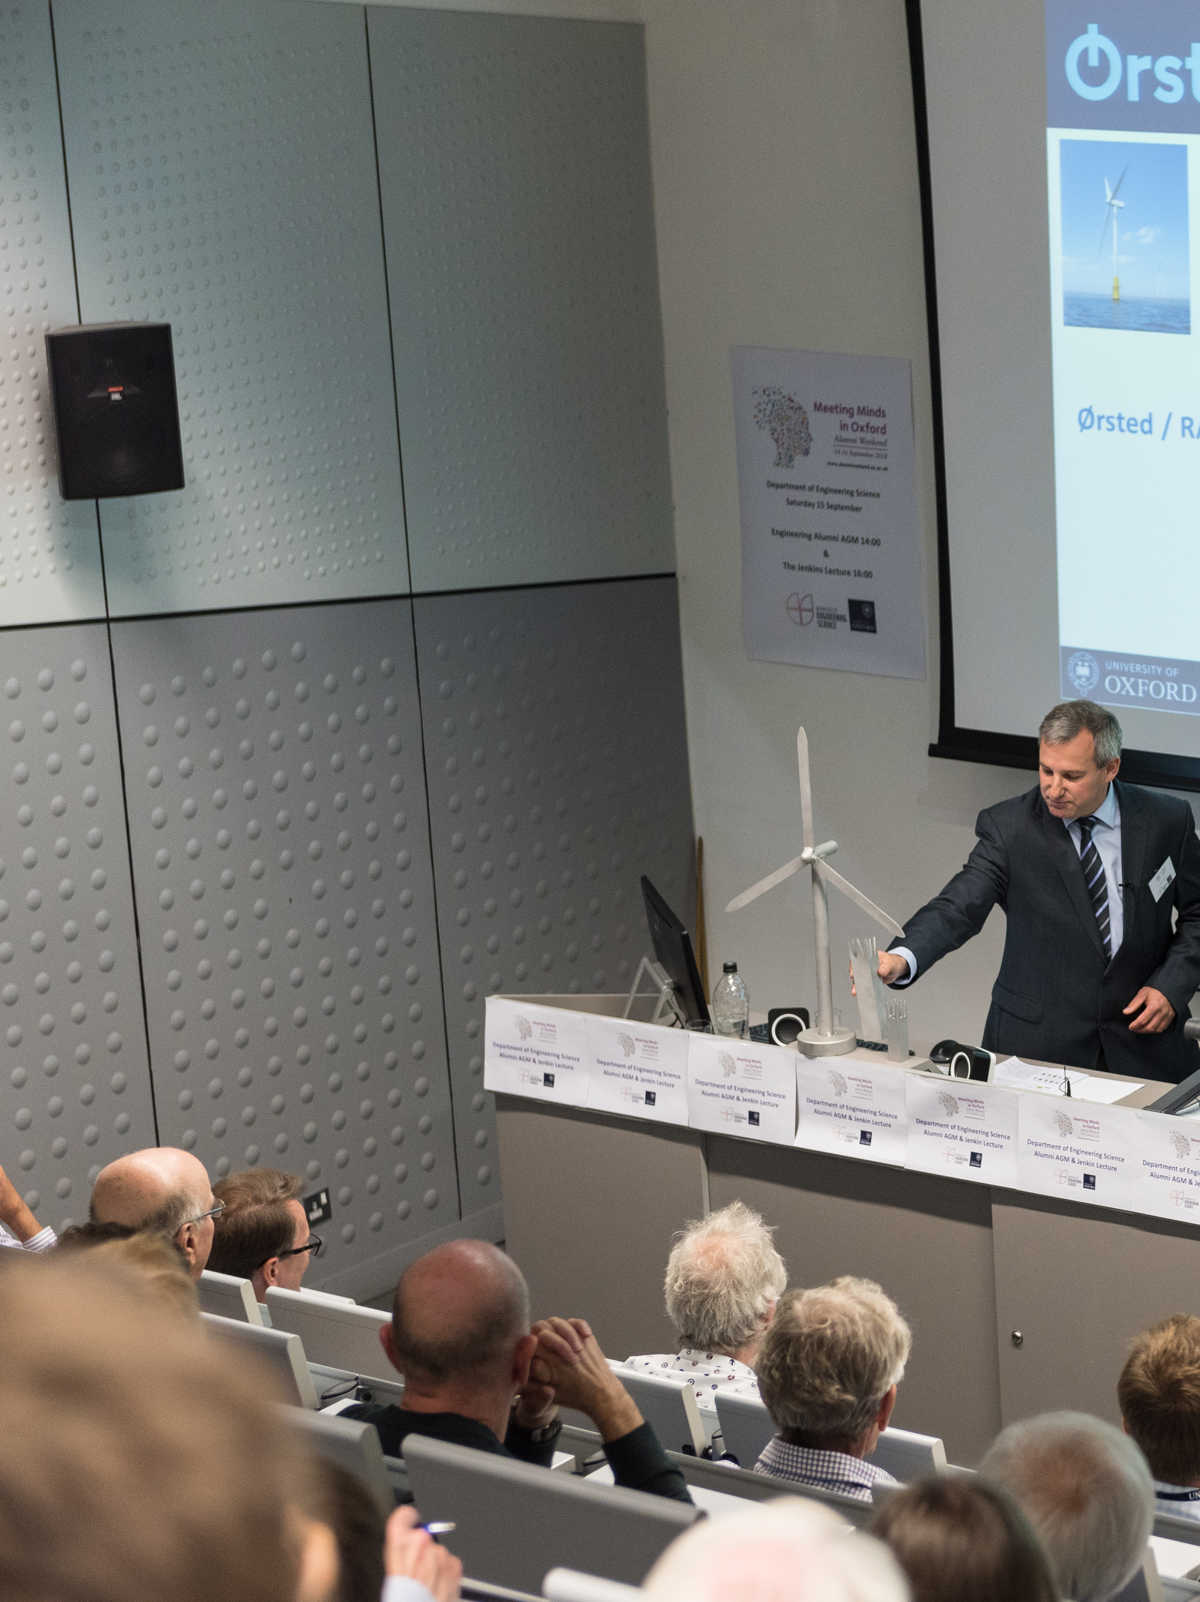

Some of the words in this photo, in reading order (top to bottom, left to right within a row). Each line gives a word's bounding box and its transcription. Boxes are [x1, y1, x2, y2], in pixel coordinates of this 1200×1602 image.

[813, 401, 855, 419] Meeting
[856, 405, 887, 418] Minds
[840, 420, 849, 432] in
[850, 421, 887, 436] Oxford
[1077, 405, 1153, 436] Ørsted
[1160, 411, 1173, 441] /
[766, 479, 806, 491] Department
[808, 484, 815, 492] of
[816, 484, 855, 498] Engineering
[856, 488, 881, 499] Science
[786, 497, 816, 510] Saturday
[817, 501, 825, 509] 15
[826, 501, 863, 512] September
[771, 528, 812, 542] Engineering
[814, 532, 839, 543] Alumni
[841, 536, 859, 544] AGM
[861, 536, 882, 546] 14:00
[823, 549, 830, 558] &
[783, 560, 796, 571] The
[825, 566, 851, 577] Lecture
[1105, 660, 1162, 677] UNIVERSITY
[1166, 667, 1179, 678] OF
[1104, 675, 1198, 703] OXFORD
[695, 1078, 726, 1090] Department
[734, 1085, 766, 1097] Engineering
[806, 1097, 838, 1109] Department
[846, 1104, 877, 1117] Engineering
[915, 1118, 950, 1130] Department
[957, 1124, 989, 1138] Engineering
[990, 1130, 1011, 1141] Science
[923, 1129, 943, 1137] Alumni
[983, 1140, 1004, 1150] Lecture
[1026, 1138, 1062, 1151] Department
[1070, 1146, 1102, 1160] Engineering
[1103, 1152, 1125, 1163] Science
[1034, 1150, 1055, 1159] Alumni
[1096, 1162, 1118, 1172] Lecture
[1142, 1159, 1178, 1173] Department
[1150, 1171, 1170, 1181] Alumni
